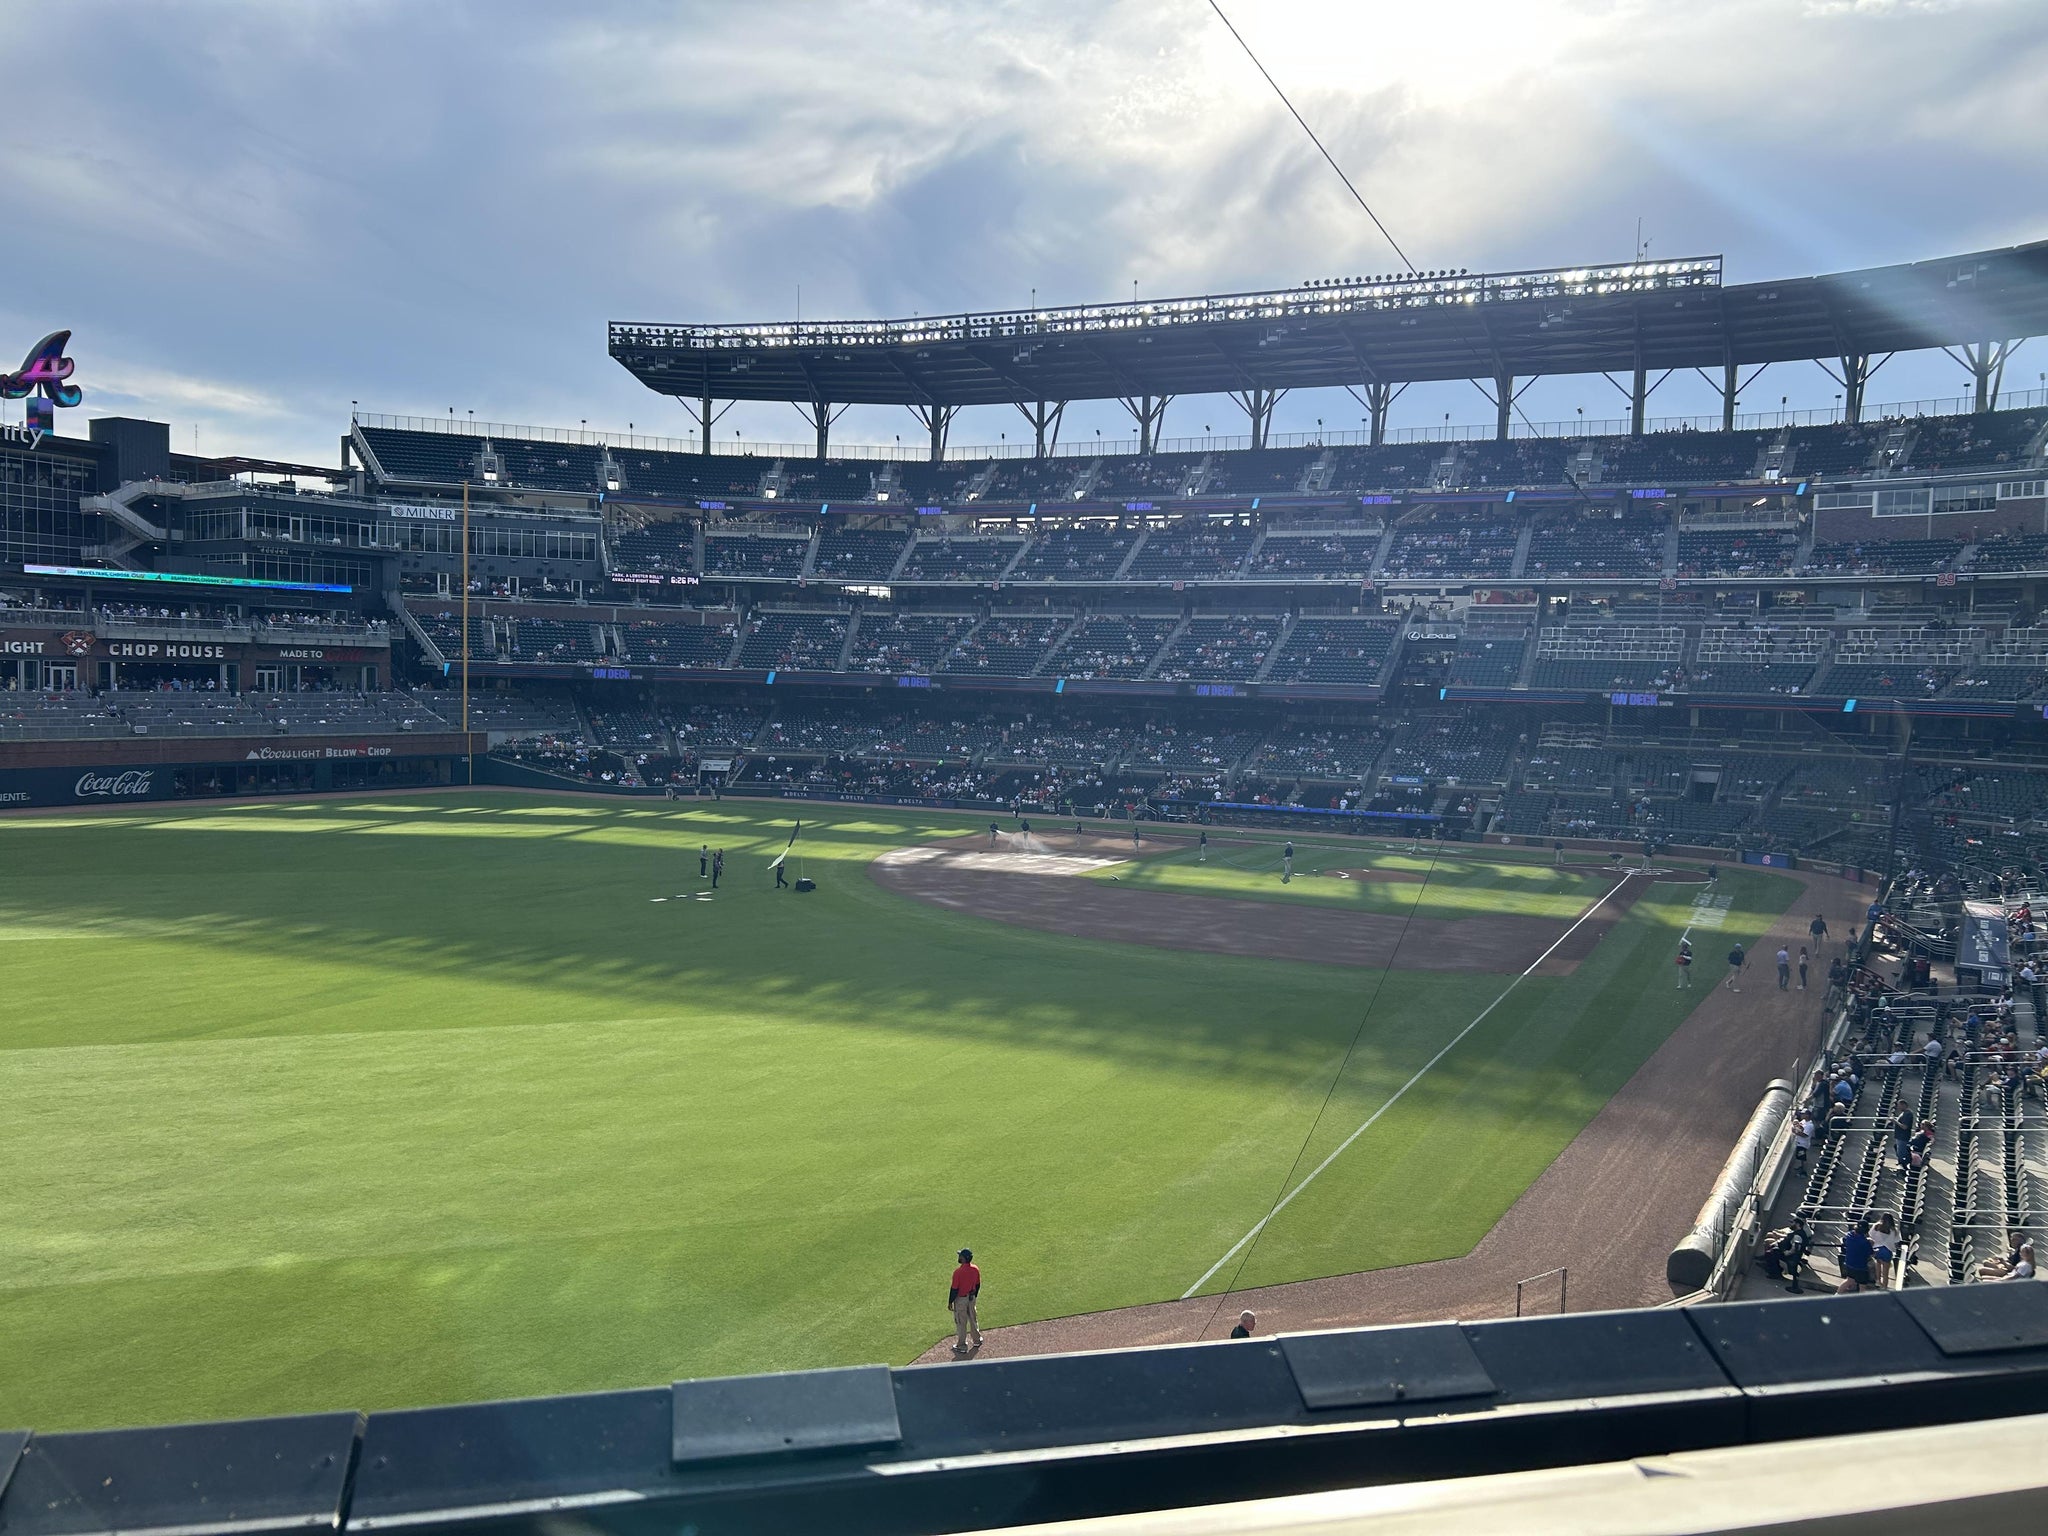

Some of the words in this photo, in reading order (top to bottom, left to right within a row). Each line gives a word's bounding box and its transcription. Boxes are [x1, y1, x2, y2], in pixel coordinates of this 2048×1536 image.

[1632, 489, 1645, 498] ON
[1645, 489, 1666, 498] DECK
[700, 501, 710, 509] ON
[406, 507, 453, 519] MILNER
[1937, 573, 1956, 586] 29
[0, 640, 45, 655] IGHT
[109, 643, 159, 657] CHOP
[166, 644, 225, 658] HOUSE
[280, 649, 309, 658] MADE
[310, 650, 323, 658] TO
[593, 668, 606, 678] ON
[607, 669, 631, 679] DECK
[899, 676, 910, 687] ON
[910, 677, 930, 687] DECK
[1197, 685, 1210, 696] ON
[1211, 685, 1234, 696] DECK
[1611, 693, 1628, 704] ON
[1629, 694, 1658, 705] DECK
[259, 747, 293, 760] Coors
[293, 750, 320, 758] LIGHT
[326, 748, 357, 757] BELOW
[367, 747, 391, 756] CHOP
[75, 770, 154, 796] Coca-Cola
